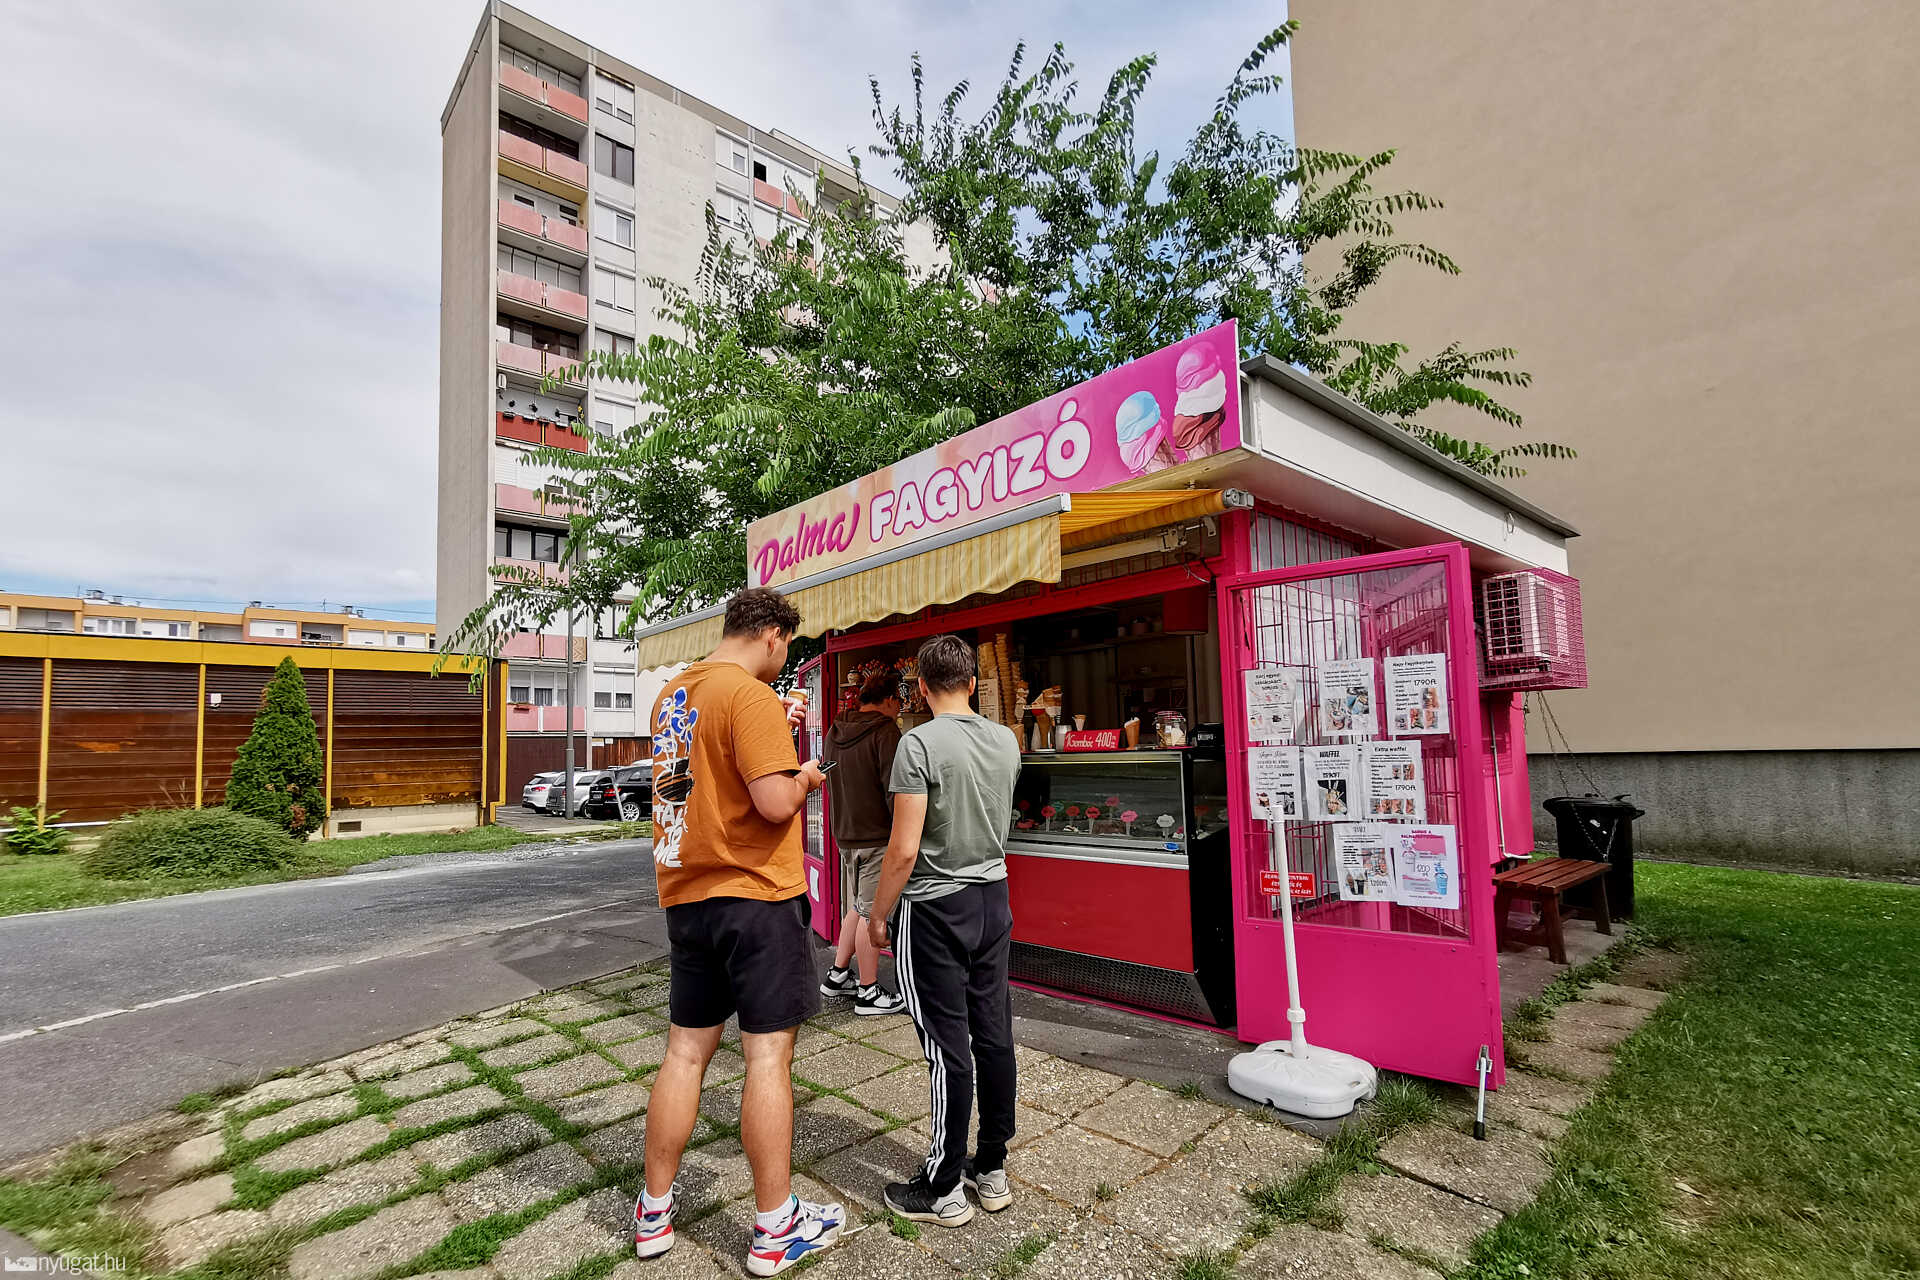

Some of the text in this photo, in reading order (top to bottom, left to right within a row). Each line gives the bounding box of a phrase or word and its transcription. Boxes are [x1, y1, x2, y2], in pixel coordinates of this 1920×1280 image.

[754, 397, 1091, 585] Dalma FAGYIZÓ
[1095, 732, 1112, 748] 400
